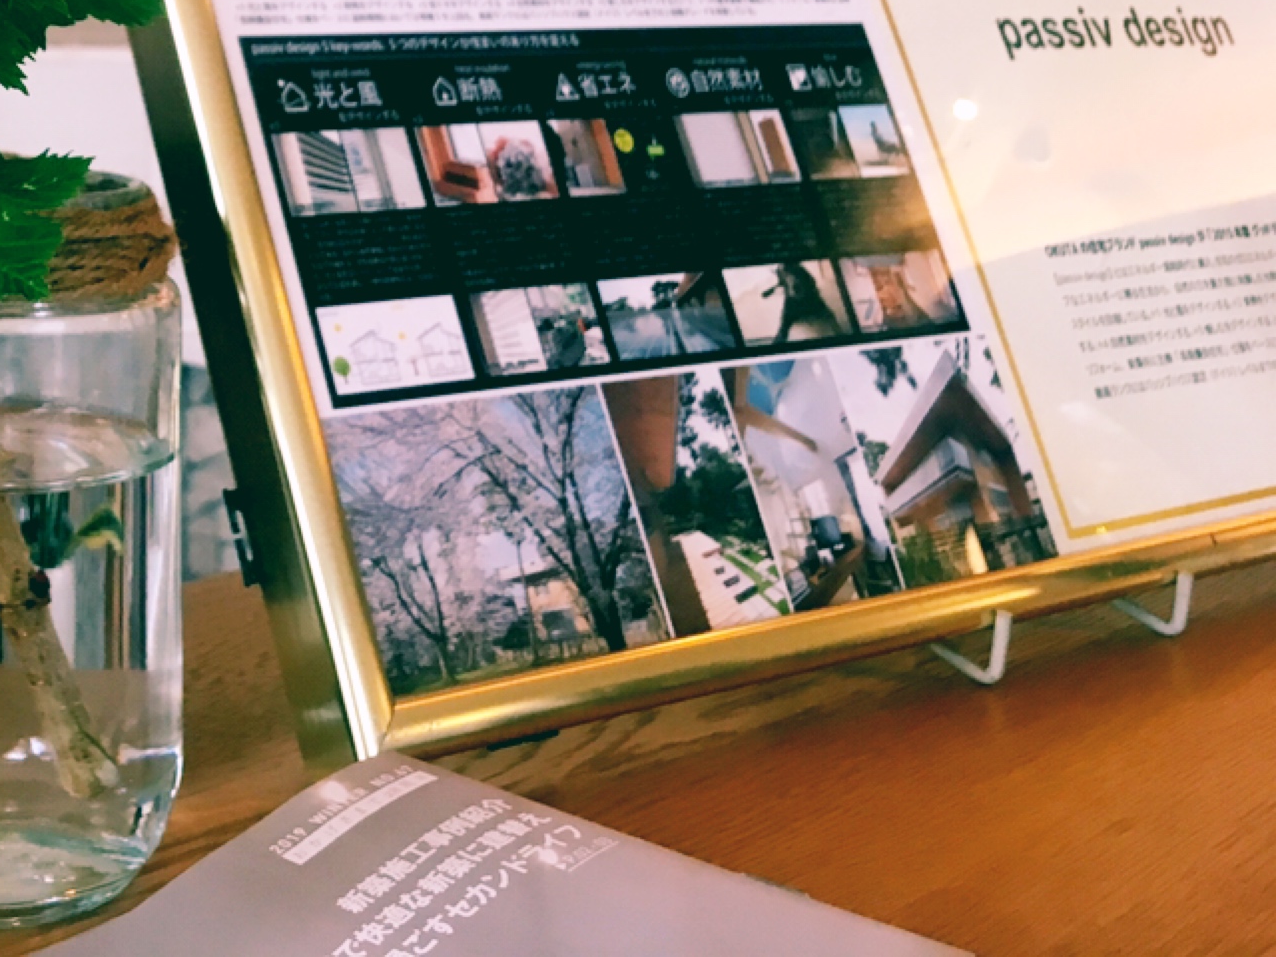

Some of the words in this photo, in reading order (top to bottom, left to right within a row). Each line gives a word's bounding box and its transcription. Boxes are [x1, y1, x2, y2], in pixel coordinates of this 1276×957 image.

[995, 5, 1113, 61] passiv
[1122, 5, 1235, 57] design
[313, 79, 384, 110] 光と風
[577, 71, 637, 99] 省エネ
